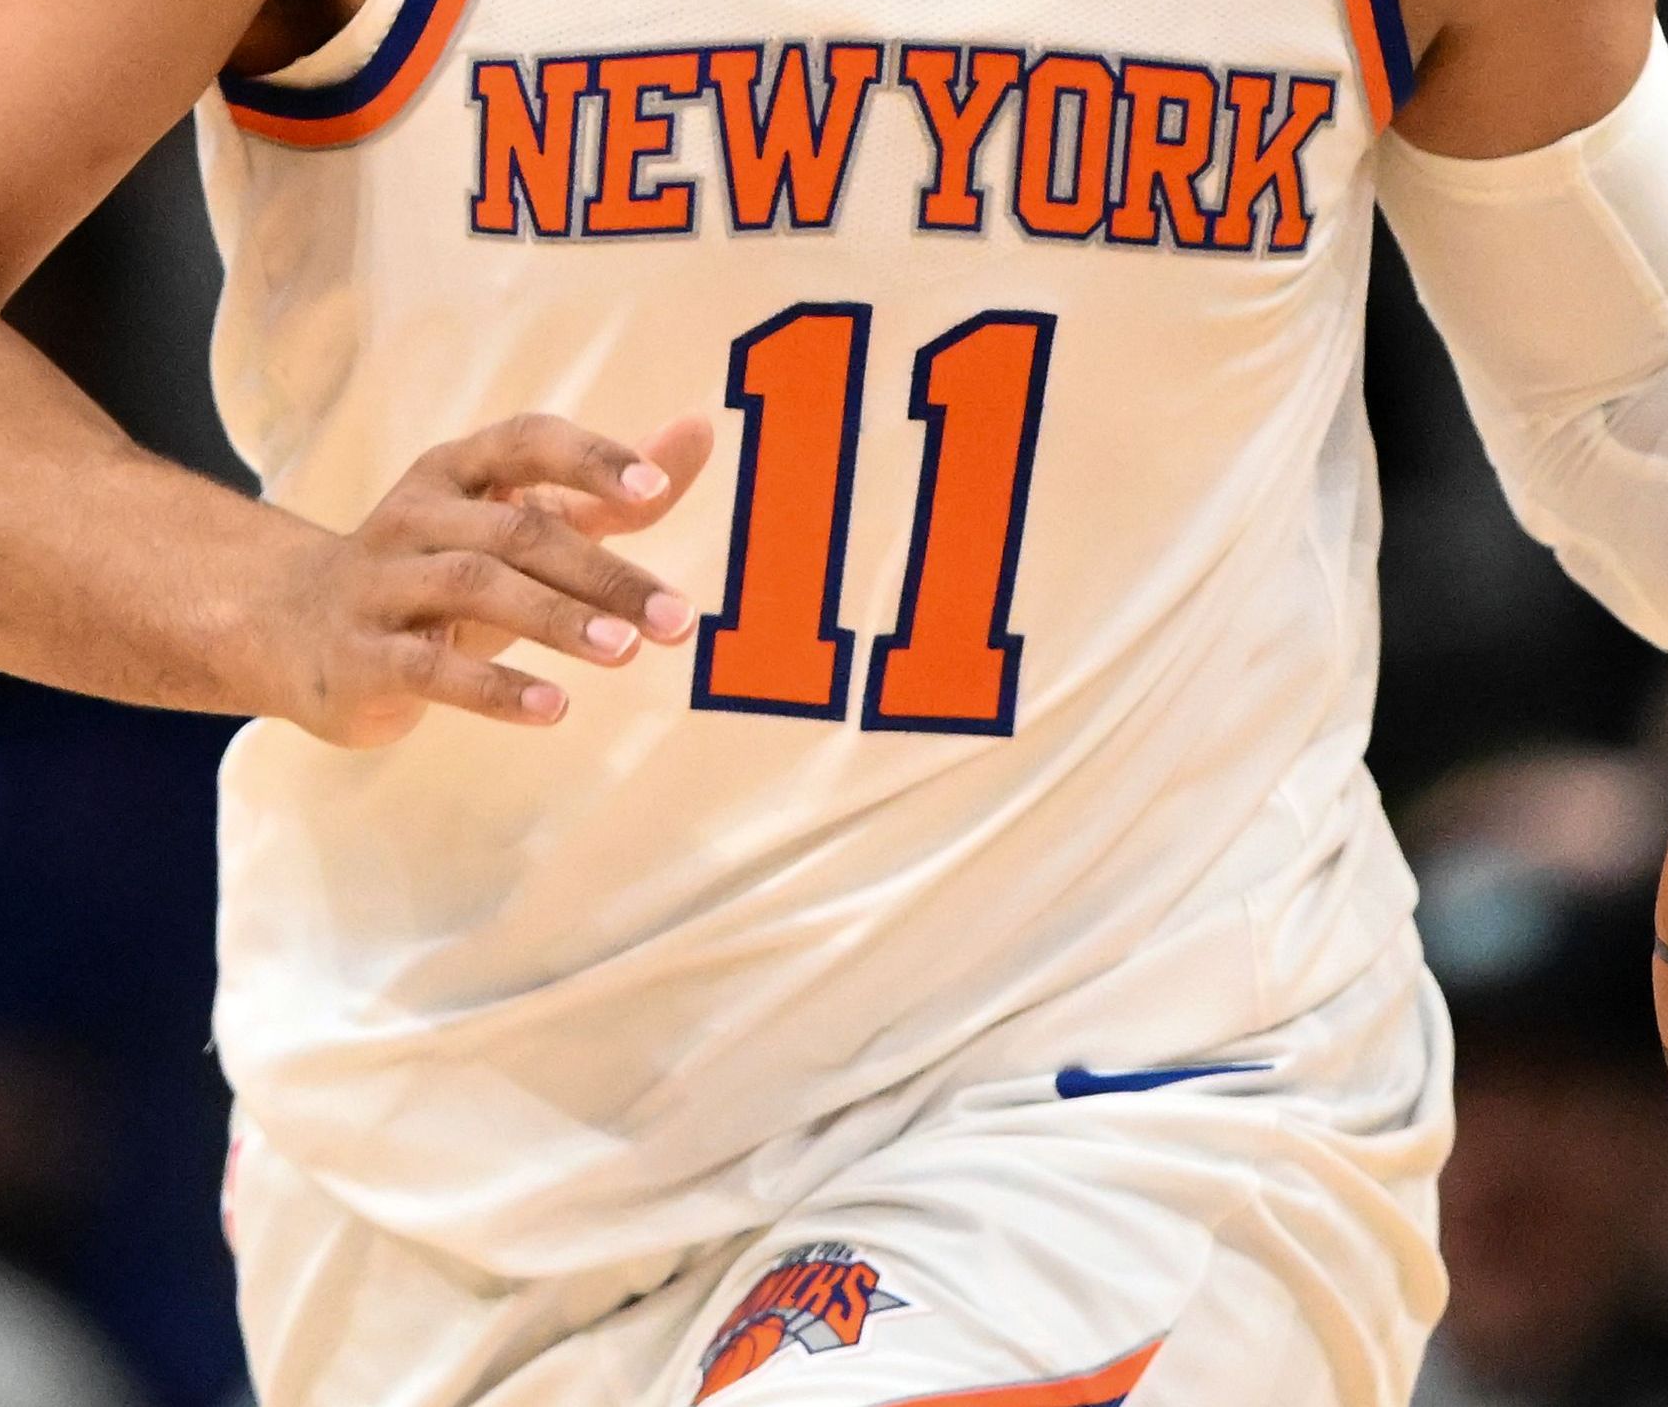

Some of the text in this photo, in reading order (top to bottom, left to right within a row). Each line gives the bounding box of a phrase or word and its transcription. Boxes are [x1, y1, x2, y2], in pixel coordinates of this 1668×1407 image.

[467, 40, 1340, 255] NEW YORK
[690, 300, 1059, 738] 11
